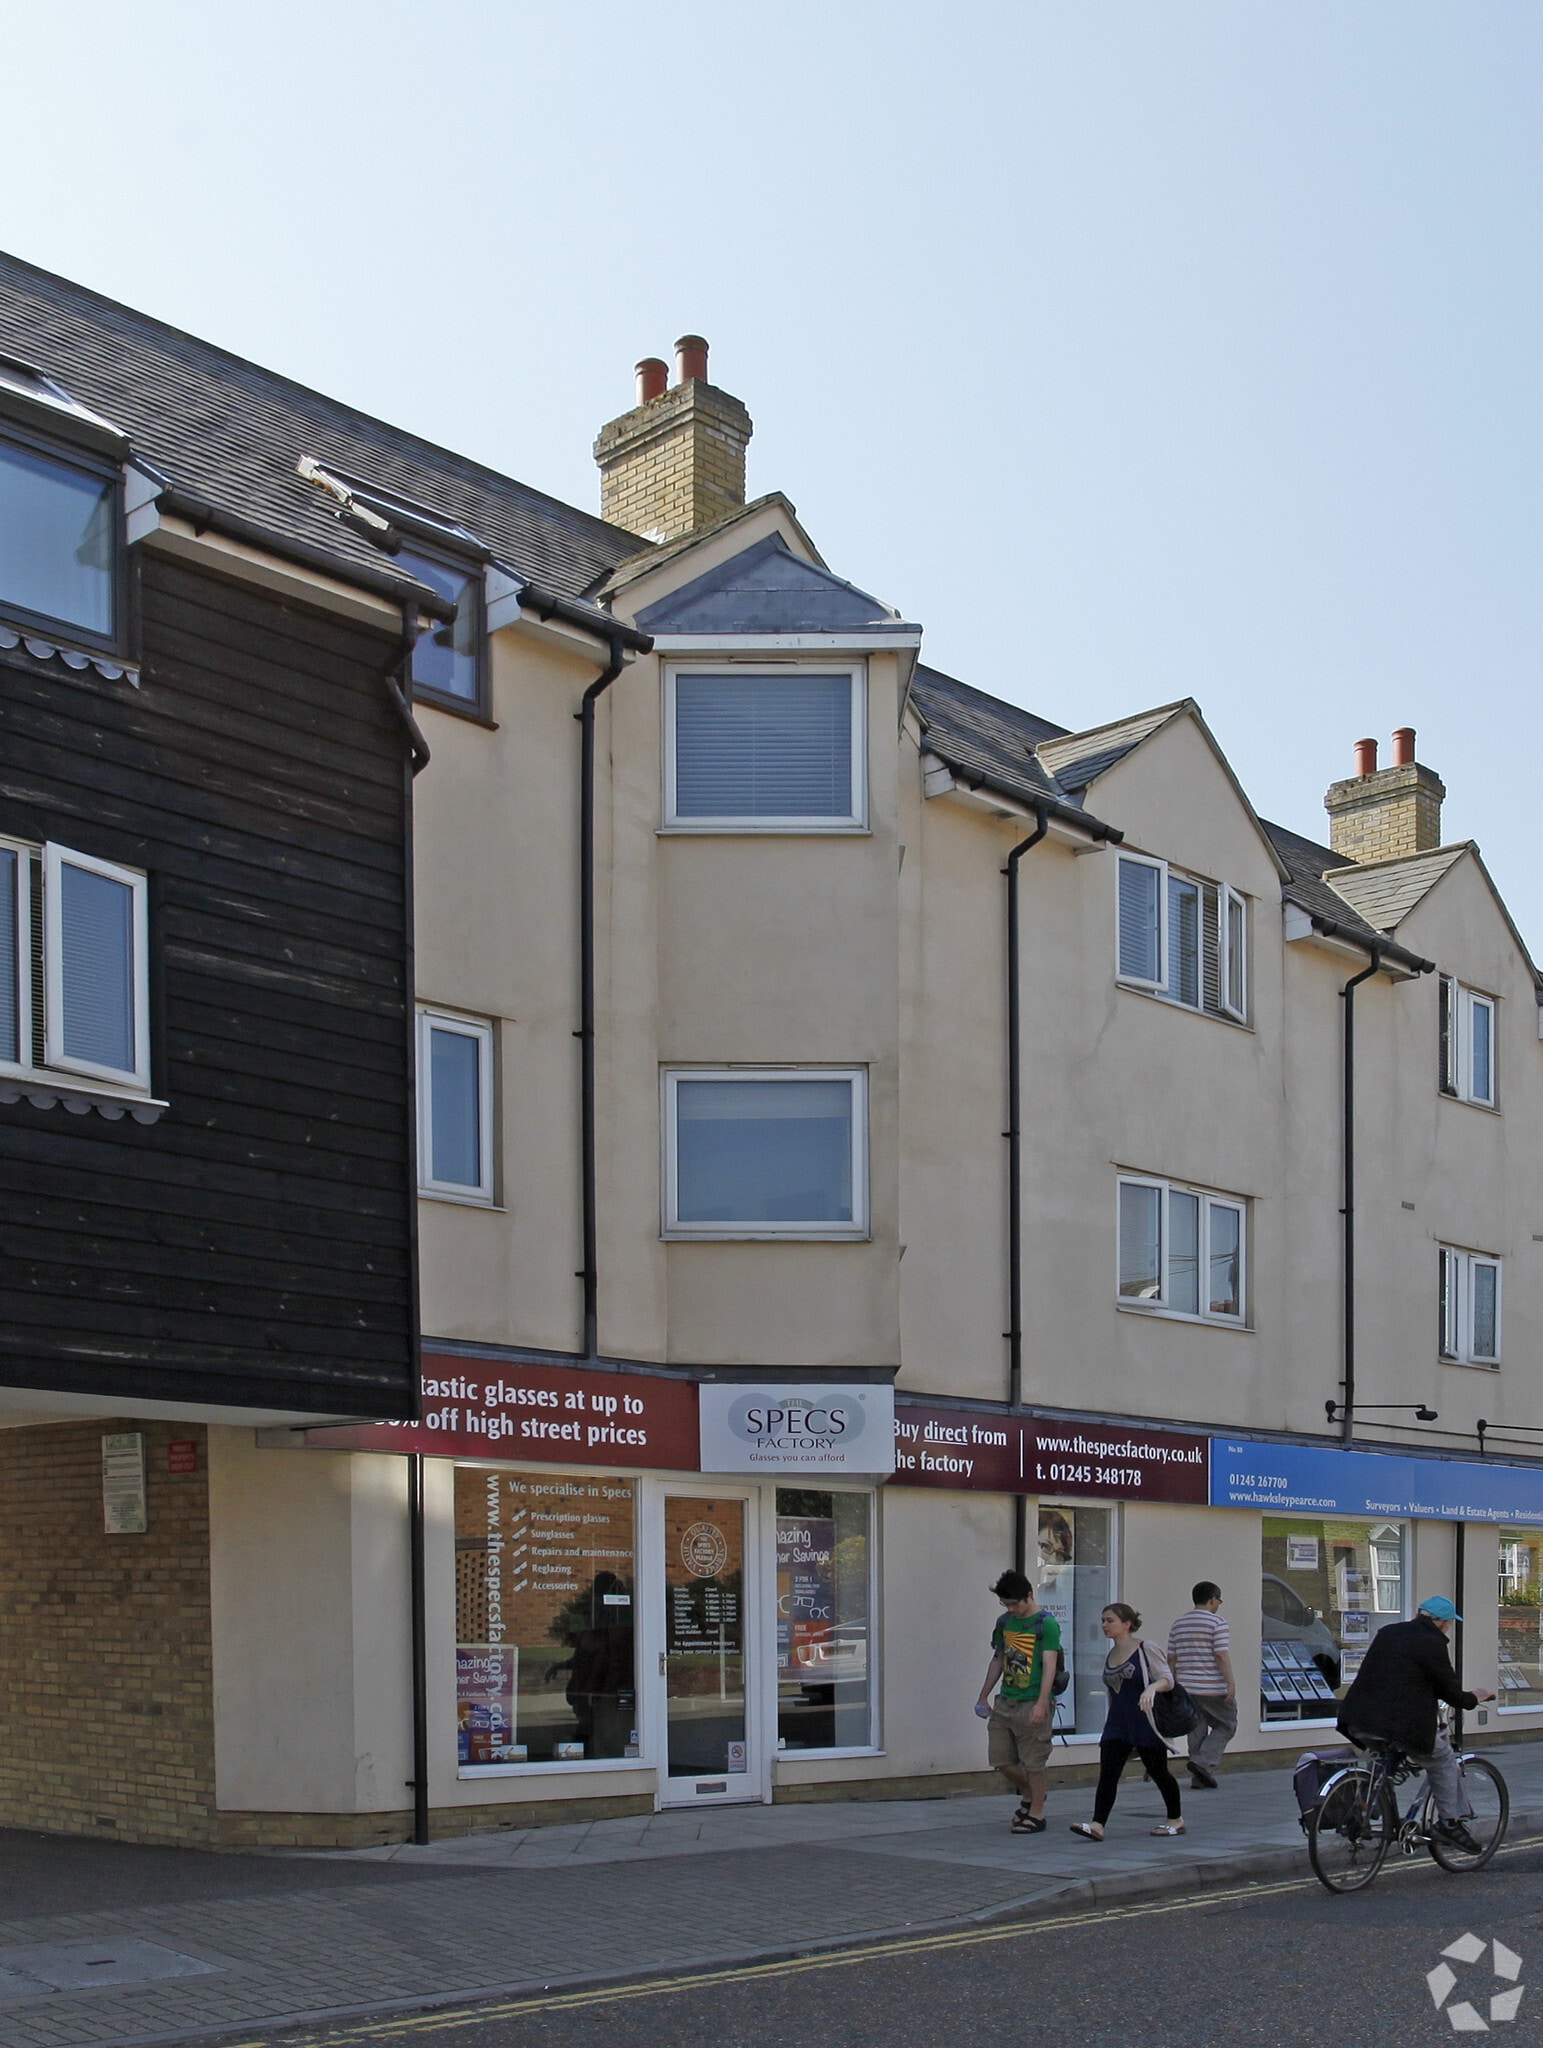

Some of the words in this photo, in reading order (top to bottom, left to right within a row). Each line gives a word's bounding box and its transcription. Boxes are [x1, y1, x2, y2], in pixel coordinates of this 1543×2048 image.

[484, 1379, 558, 1408] glasses
[564, 1390, 586, 1410] at
[592, 1395, 617, 1416] up
[623, 1395, 644, 1415] to
[426, 1407, 459, 1431] off
[466, 1409, 514, 1440] high
[521, 1417, 581, 1441] street
[587, 1422, 647, 1447] prices
[747, 1408, 846, 1435] SPECS
[893, 1418, 919, 1443] Buy
[924, 1420, 968, 1444] direct
[971, 1425, 1007, 1446] from
[757, 1437, 837, 1449] FACTORY
[1036, 1435, 1203, 1465] www.thespecsfactory.co.uk
[749, 1453, 780, 1462] Glasses
[782, 1455, 798, 1463] you
[818, 1453, 846, 1462] afford
[920, 1450, 974, 1478] factory
[1036, 1463, 1046, 1480] t.
[1050, 1464, 1092, 1482] 01245
[1095, 1467, 1142, 1487] 348178
[1229, 1473, 1256, 1487] 01245
[1258, 1476, 1288, 1489] 267700
[509, 1481, 527, 1494] We
[530, 1482, 585, 1497] specialise
[588, 1484, 599, 1496] in
[602, 1485, 632, 1499] Specs
[1229, 1491, 1336, 1508] www.hawksleypearce.com
[531, 1512, 581, 1523] Prescription
[582, 1513, 610, 1524] glasses
[1365, 1499, 1401, 1514] Surveyors
[1408, 1502, 1434, 1514] Valuers
[1441, 1505, 1458, 1515] Land
[1459, 1506, 1465, 1515] &
[1466, 1506, 1486, 1517] Estate
[1487, 1508, 1509, 1521] Agents
[531, 1529, 575, 1540] Sunglasses
[531, 1547, 563, 1557] Repairs
[564, 1547, 580, 1556] and
[582, 1548, 633, 1558] maintenance
[793, 1547, 830, 1565] Savings
[531, 1564, 572, 1575] Reglazing
[531, 1581, 578, 1590] Accessories
[484, 1474, 506, 1759] www.thespecsfactory.co.uk
